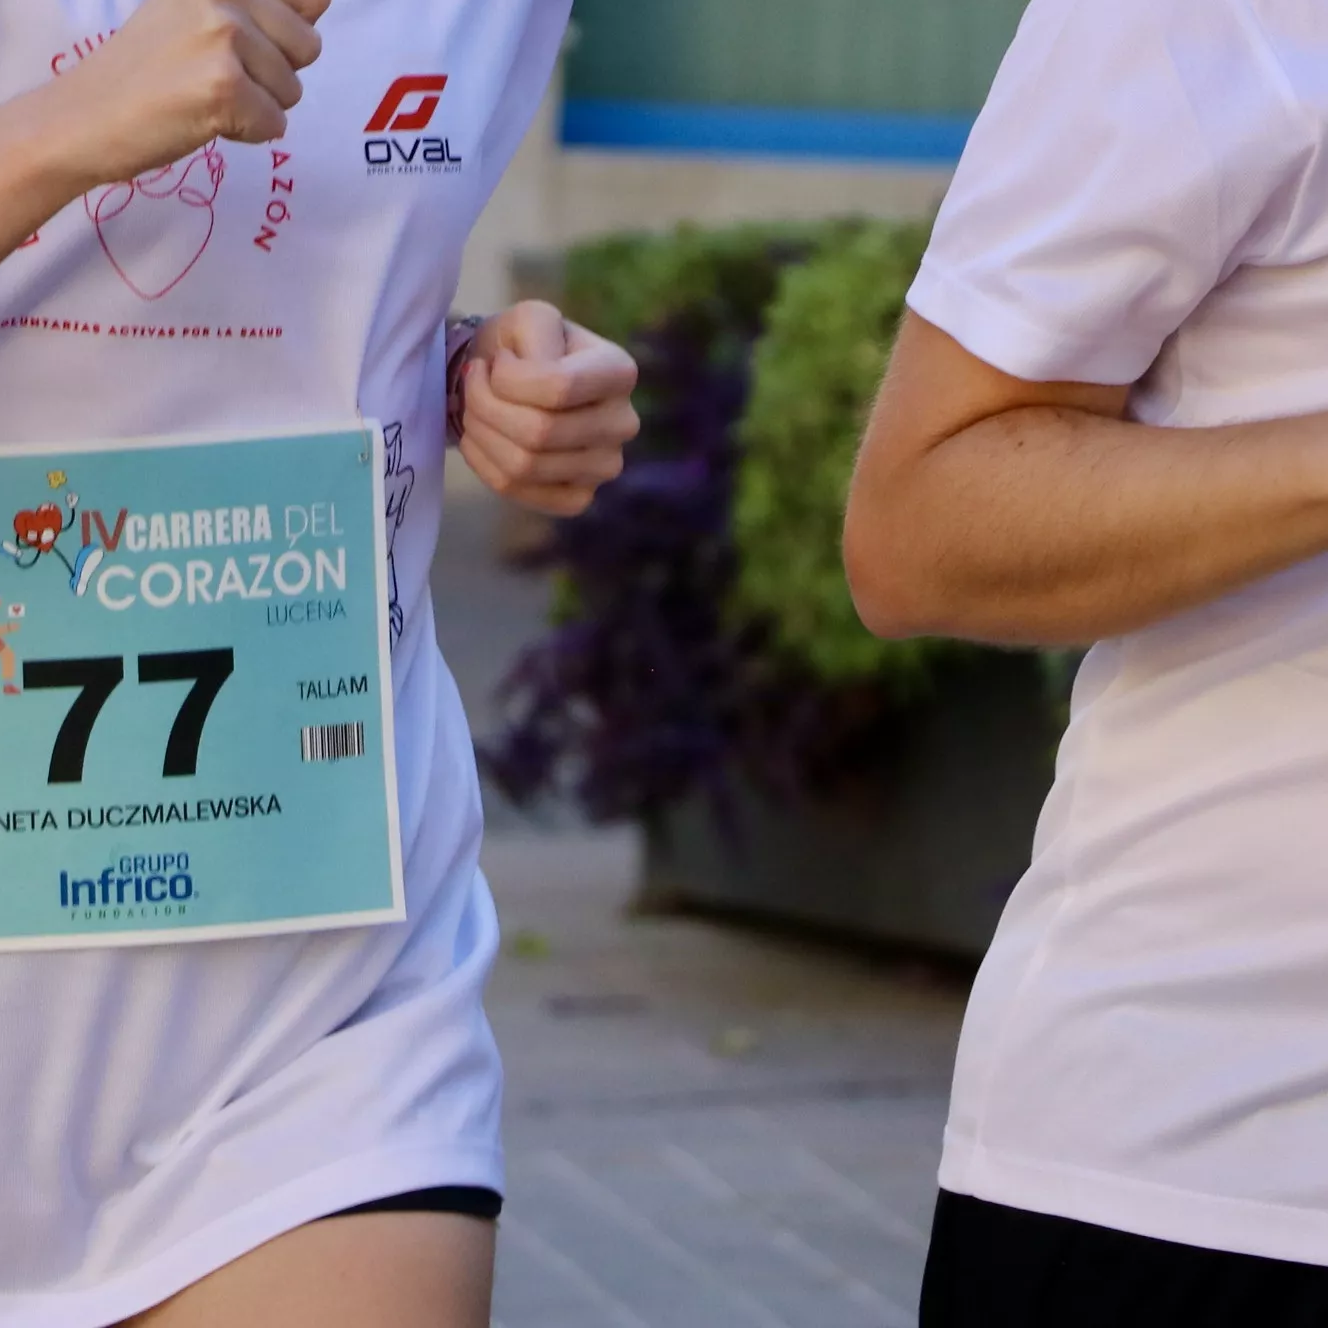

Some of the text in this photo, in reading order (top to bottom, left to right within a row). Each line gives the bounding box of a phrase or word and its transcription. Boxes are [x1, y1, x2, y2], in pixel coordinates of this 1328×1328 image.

[108, 325, 176, 338] ACTIVAS
[182, 326, 210, 338] POR
[217, 327, 233, 337] LA
[239, 327, 283, 338] SALUD
[125, 504, 272, 553] CARRERA
[284, 502, 345, 539] DEL
[266, 598, 348, 627] LUCENA
[22, 647, 234, 785] 77
[68, 793, 283, 831] DUCZMALEWSKA
[119, 851, 190, 875] GRUPO
